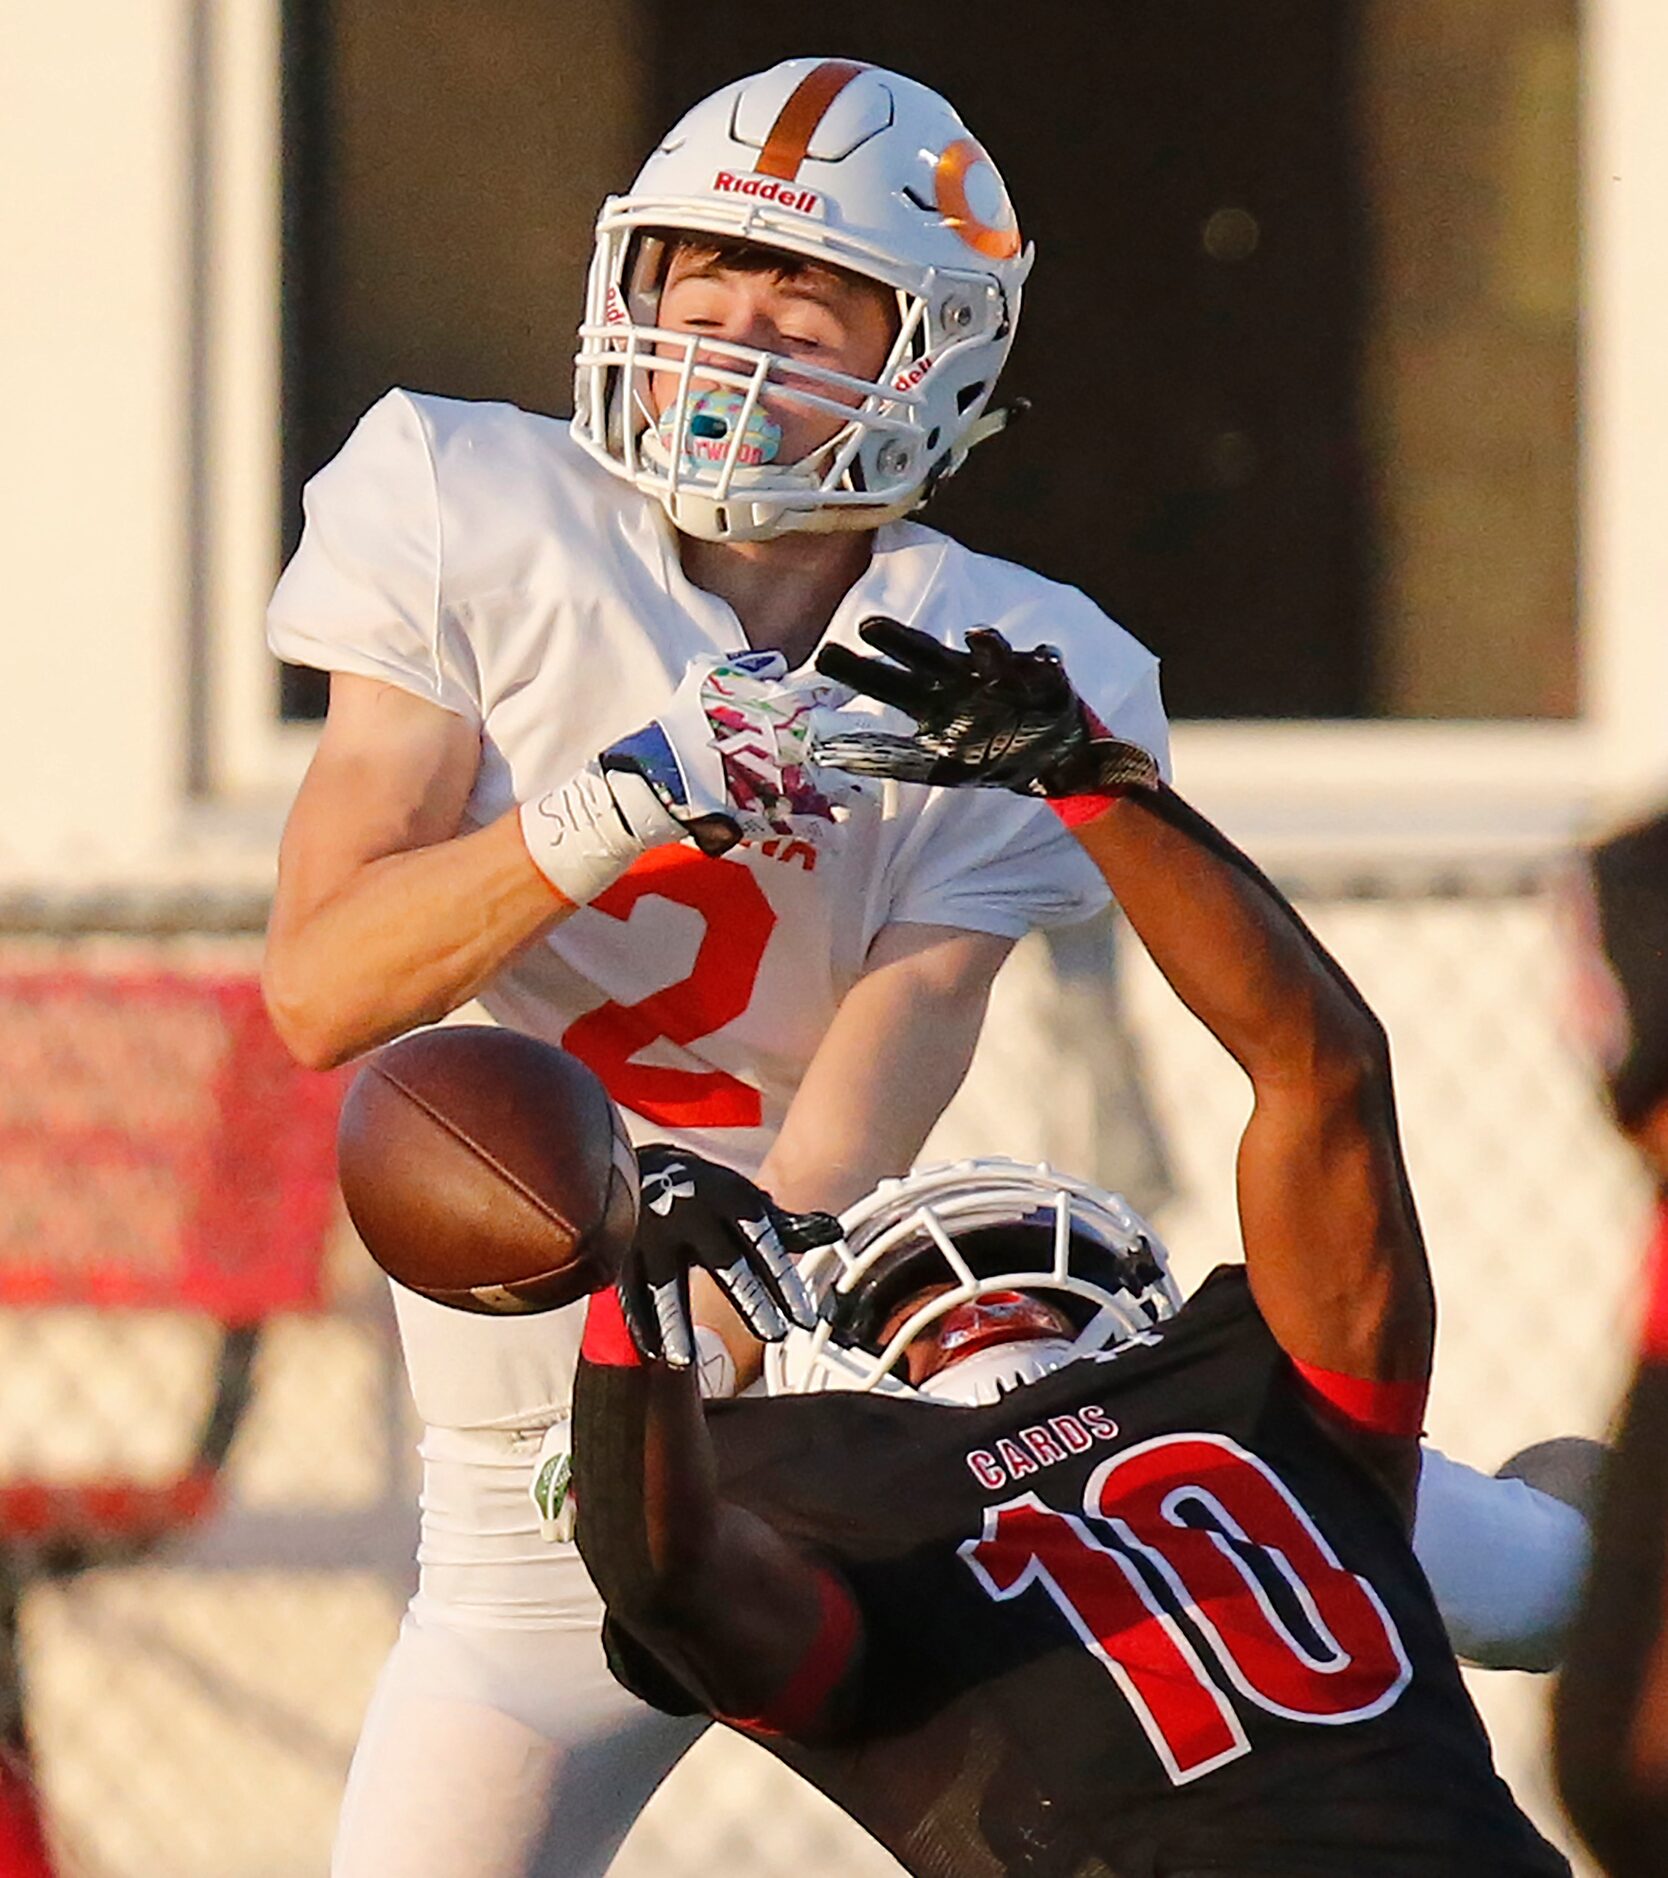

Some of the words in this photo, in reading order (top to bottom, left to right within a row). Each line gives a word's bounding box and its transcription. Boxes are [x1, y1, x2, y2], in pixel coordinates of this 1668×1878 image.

[713, 170, 818, 214] Riddell
[894, 356, 933, 392] dell
[561, 841, 778, 1128] 2
[966, 1404, 1120, 1490] CARDS
[955, 1432, 1414, 1787] 10
